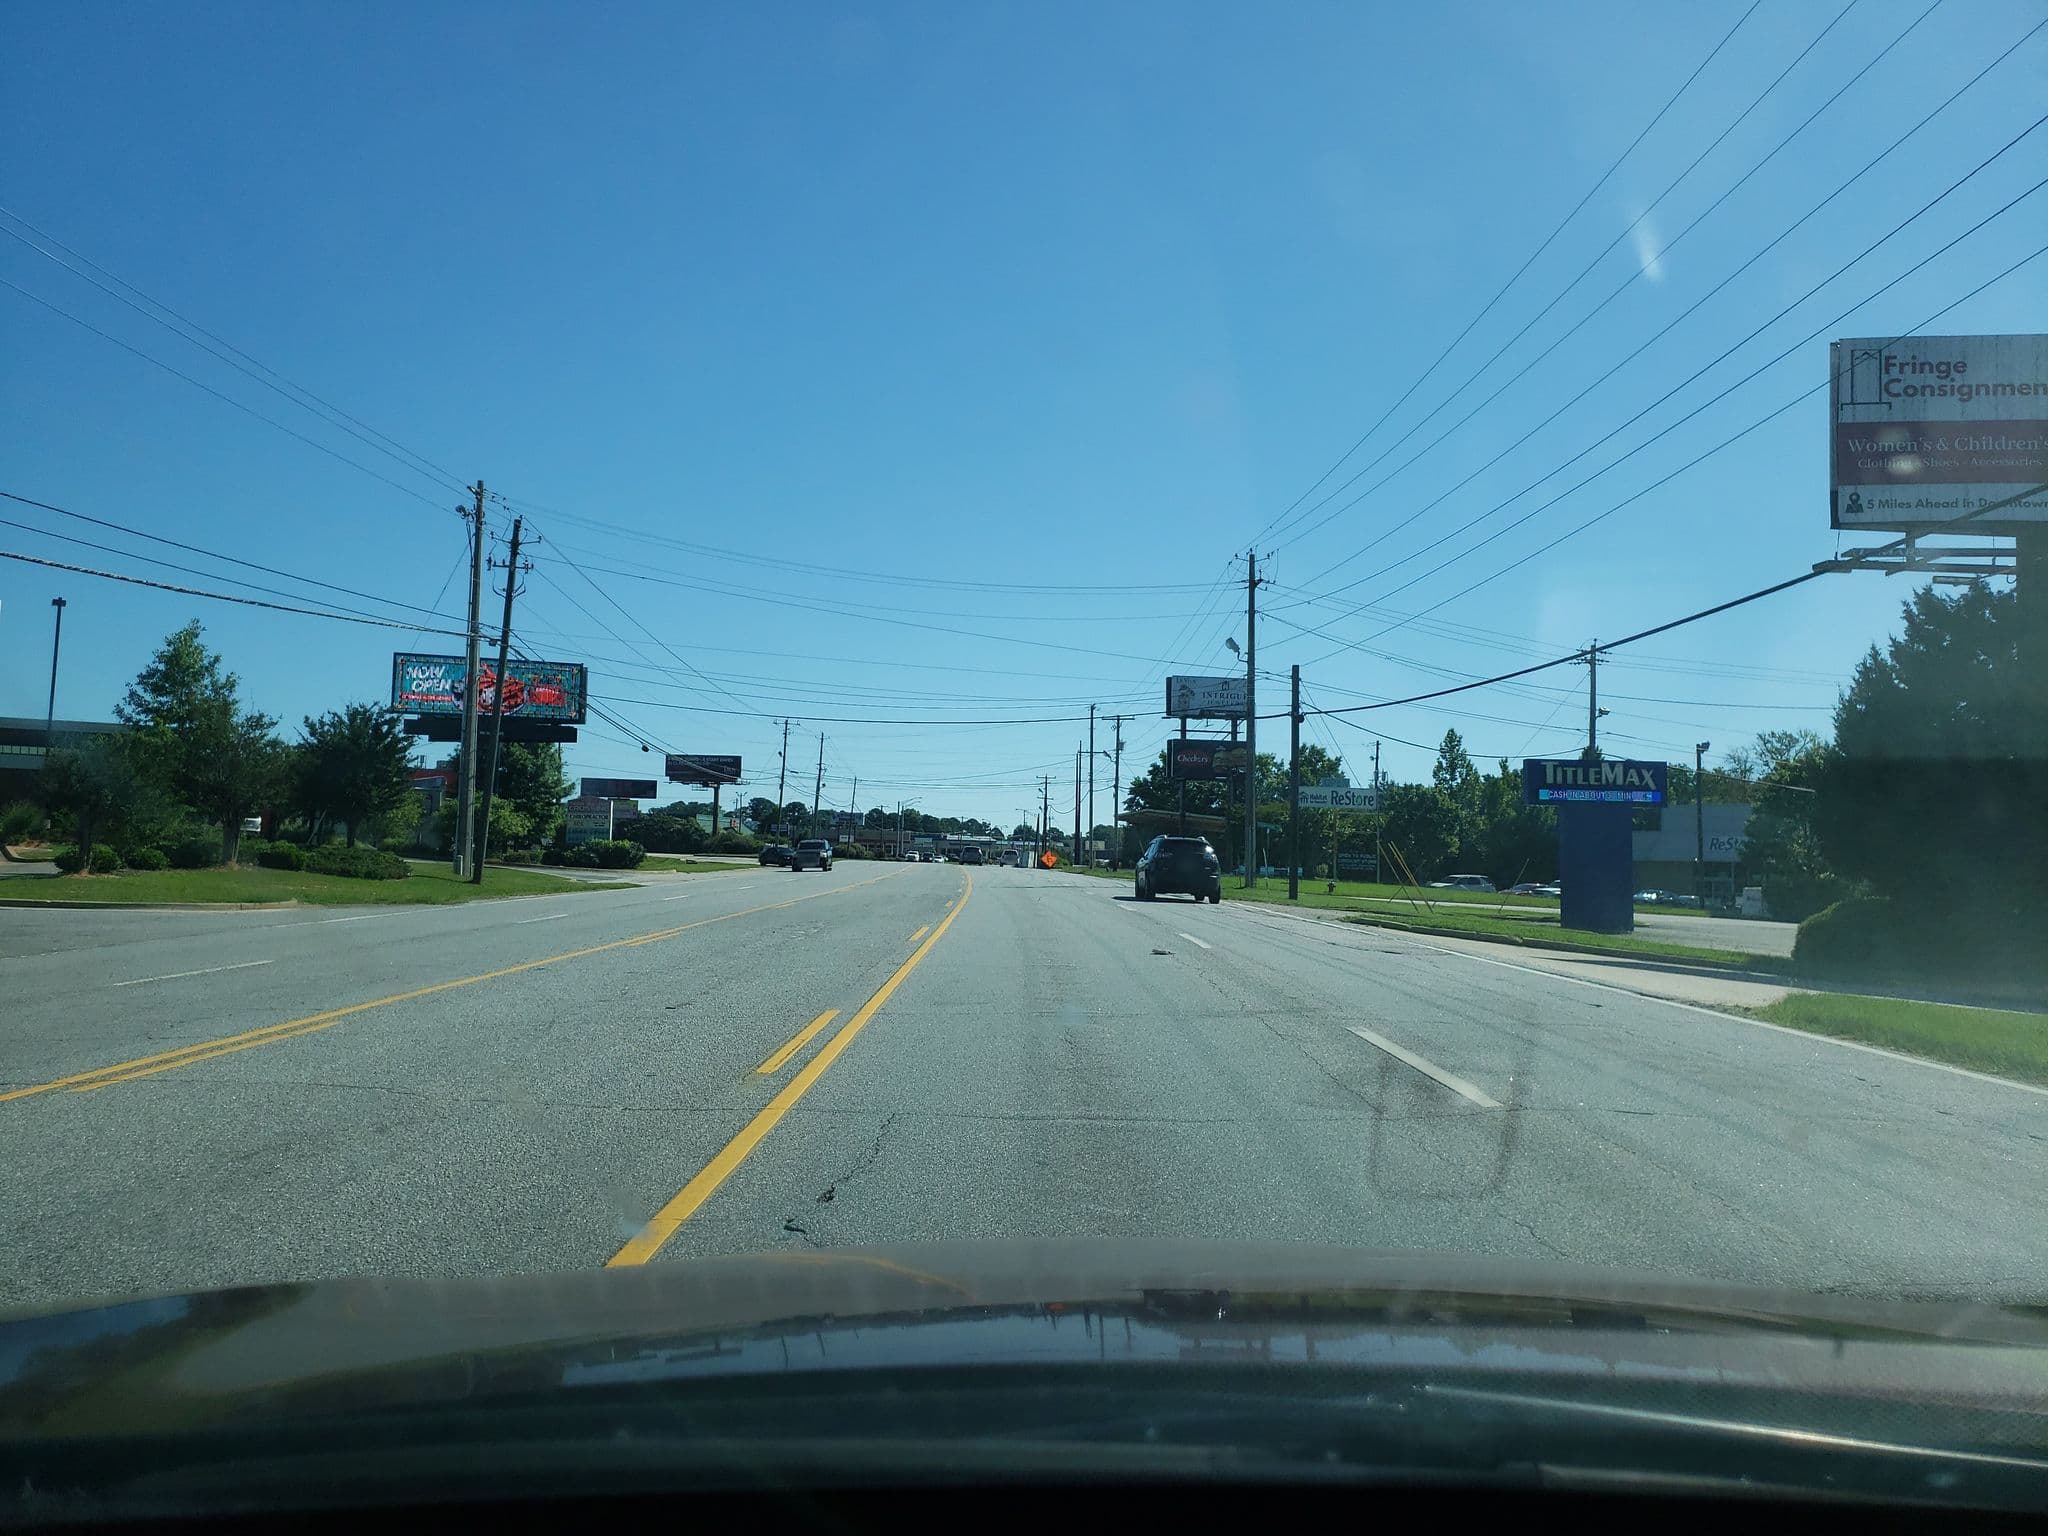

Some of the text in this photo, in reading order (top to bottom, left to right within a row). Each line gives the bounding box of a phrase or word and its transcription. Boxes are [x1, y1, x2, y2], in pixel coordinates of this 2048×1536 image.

[1884, 354, 1967, 379] Fringe
[1848, 437, 1931, 453] Women's
[1936, 438, 1949, 451] &
[1866, 499, 1875, 509] 5
[1878, 498, 1911, 508] Miles
[1915, 497, 1958, 508] Ahead
[406, 666, 446, 680] NOW
[411, 679, 452, 693] OPEN
[1331, 790, 1374, 806] ReStore
[1549, 791, 1568, 799] CASH
